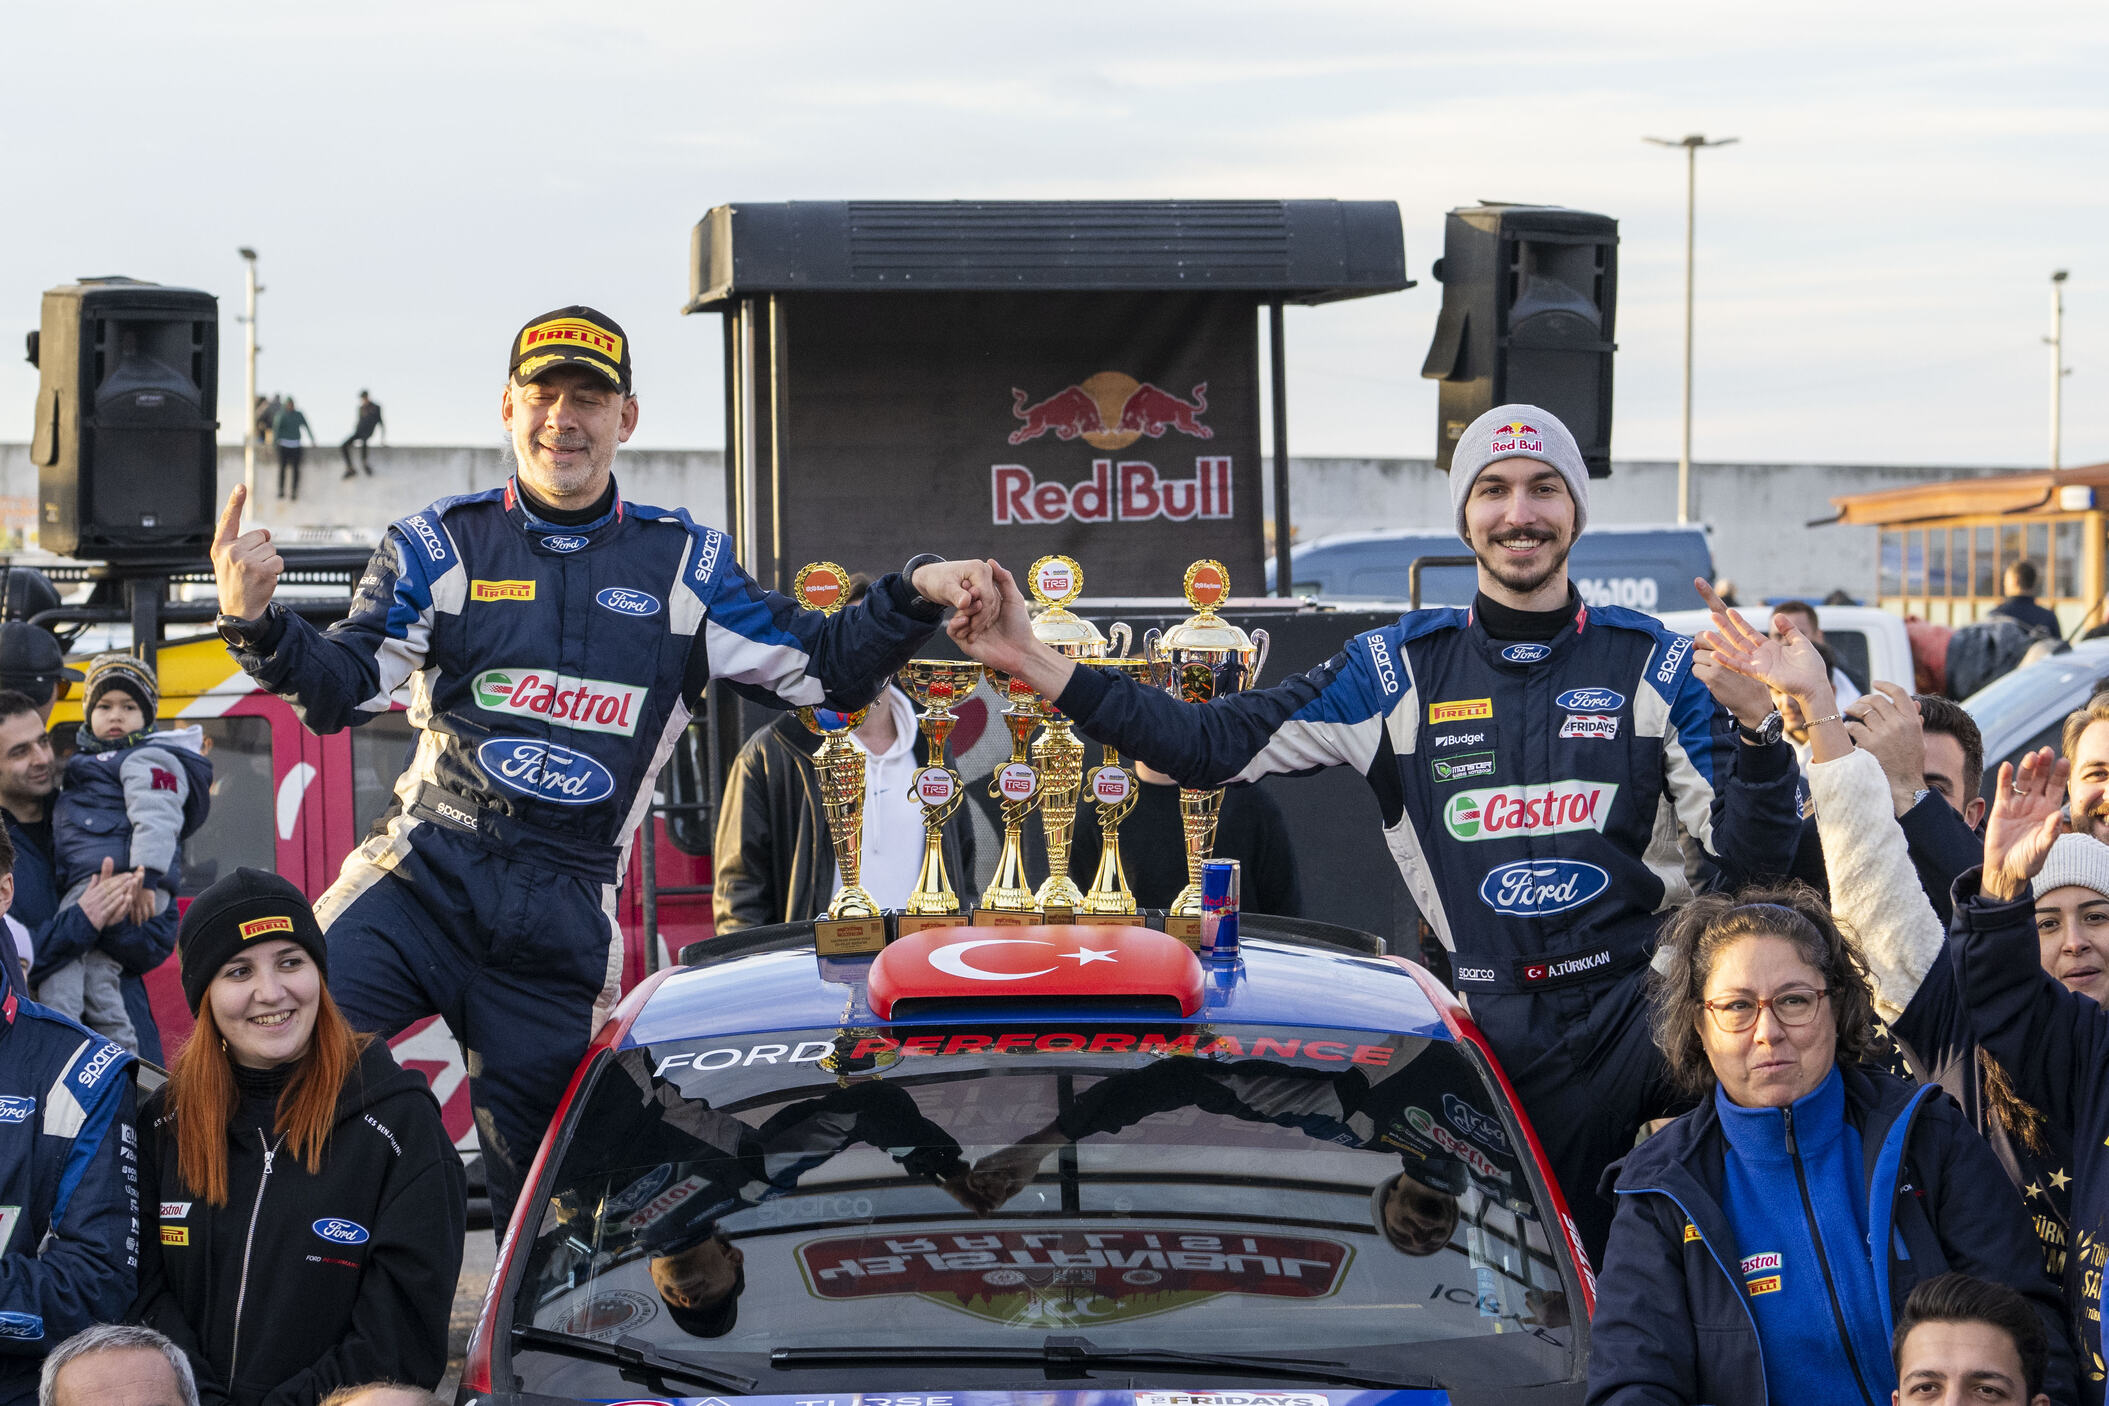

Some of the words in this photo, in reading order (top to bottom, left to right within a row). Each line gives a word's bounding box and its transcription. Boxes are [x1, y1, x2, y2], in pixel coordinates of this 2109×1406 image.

[526, 324, 616, 352] PIRELLI
[1492, 439, 1515, 453] Red
[1519, 440, 1542, 452] Bull
[991, 459, 1113, 524] Red
[1117, 456, 1233, 521] Bull
[405, 515, 446, 562] sparco
[551, 537, 580, 550] Ford
[695, 529, 721, 584] sparco
[477, 583, 531, 598] PIRELLI
[1044, 579, 1067, 588] TRS
[607, 590, 649, 613] Ford
[1511, 644, 1543, 661] Ford
[1657, 636, 1692, 685] sparco
[1367, 634, 1399, 696] sparco
[510, 675, 633, 728] Castrol
[1569, 689, 1613, 708] Ford
[1434, 702, 1487, 719] PIRELLI
[1570, 721, 1615, 734] FRIDAYS
[1448, 733, 1484, 746] Budget
[501, 744, 593, 797] Ford
[924, 786, 947, 794] TRS
[1006, 780, 1029, 790] TRS
[1099, 783, 1122, 793] TRS
[1483, 789, 1601, 832] Castrol
[1496, 867, 1579, 907] Ford
[1203, 895, 1222, 906] Red
[244, 919, 289, 937] PIRELLI
[1548, 951, 1611, 978] A.TÜRKKAN
[1458, 967, 1495, 982] sparco
[653, 1040, 837, 1078] FORD
[850, 1032, 1396, 1067] PERFORMANCE
[78, 1042, 125, 1088] sparco
[323, 1220, 358, 1241] Ford
[306, 1255, 322, 1263] FORD
[1740, 1254, 1779, 1273] astrol
